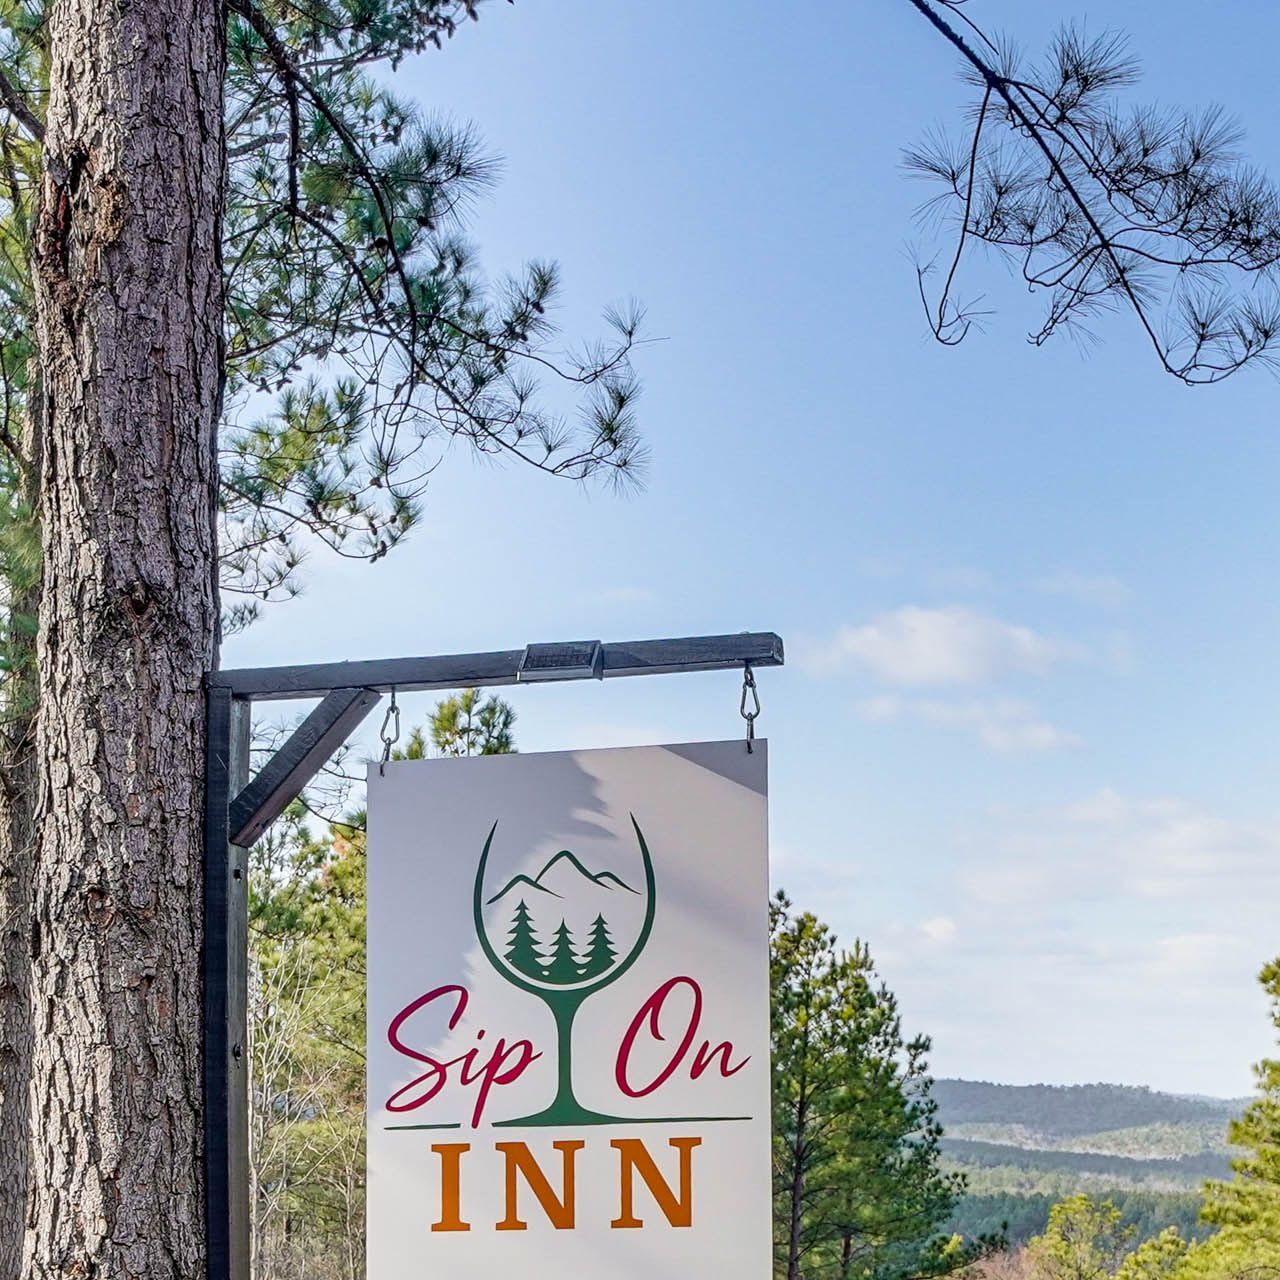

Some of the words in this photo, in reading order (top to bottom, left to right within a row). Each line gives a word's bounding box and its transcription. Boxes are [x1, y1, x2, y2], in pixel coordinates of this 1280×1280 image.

[385, 984, 542, 1129] Sip
[615, 976, 752, 1098] On
[430, 1136, 703, 1233] INN
